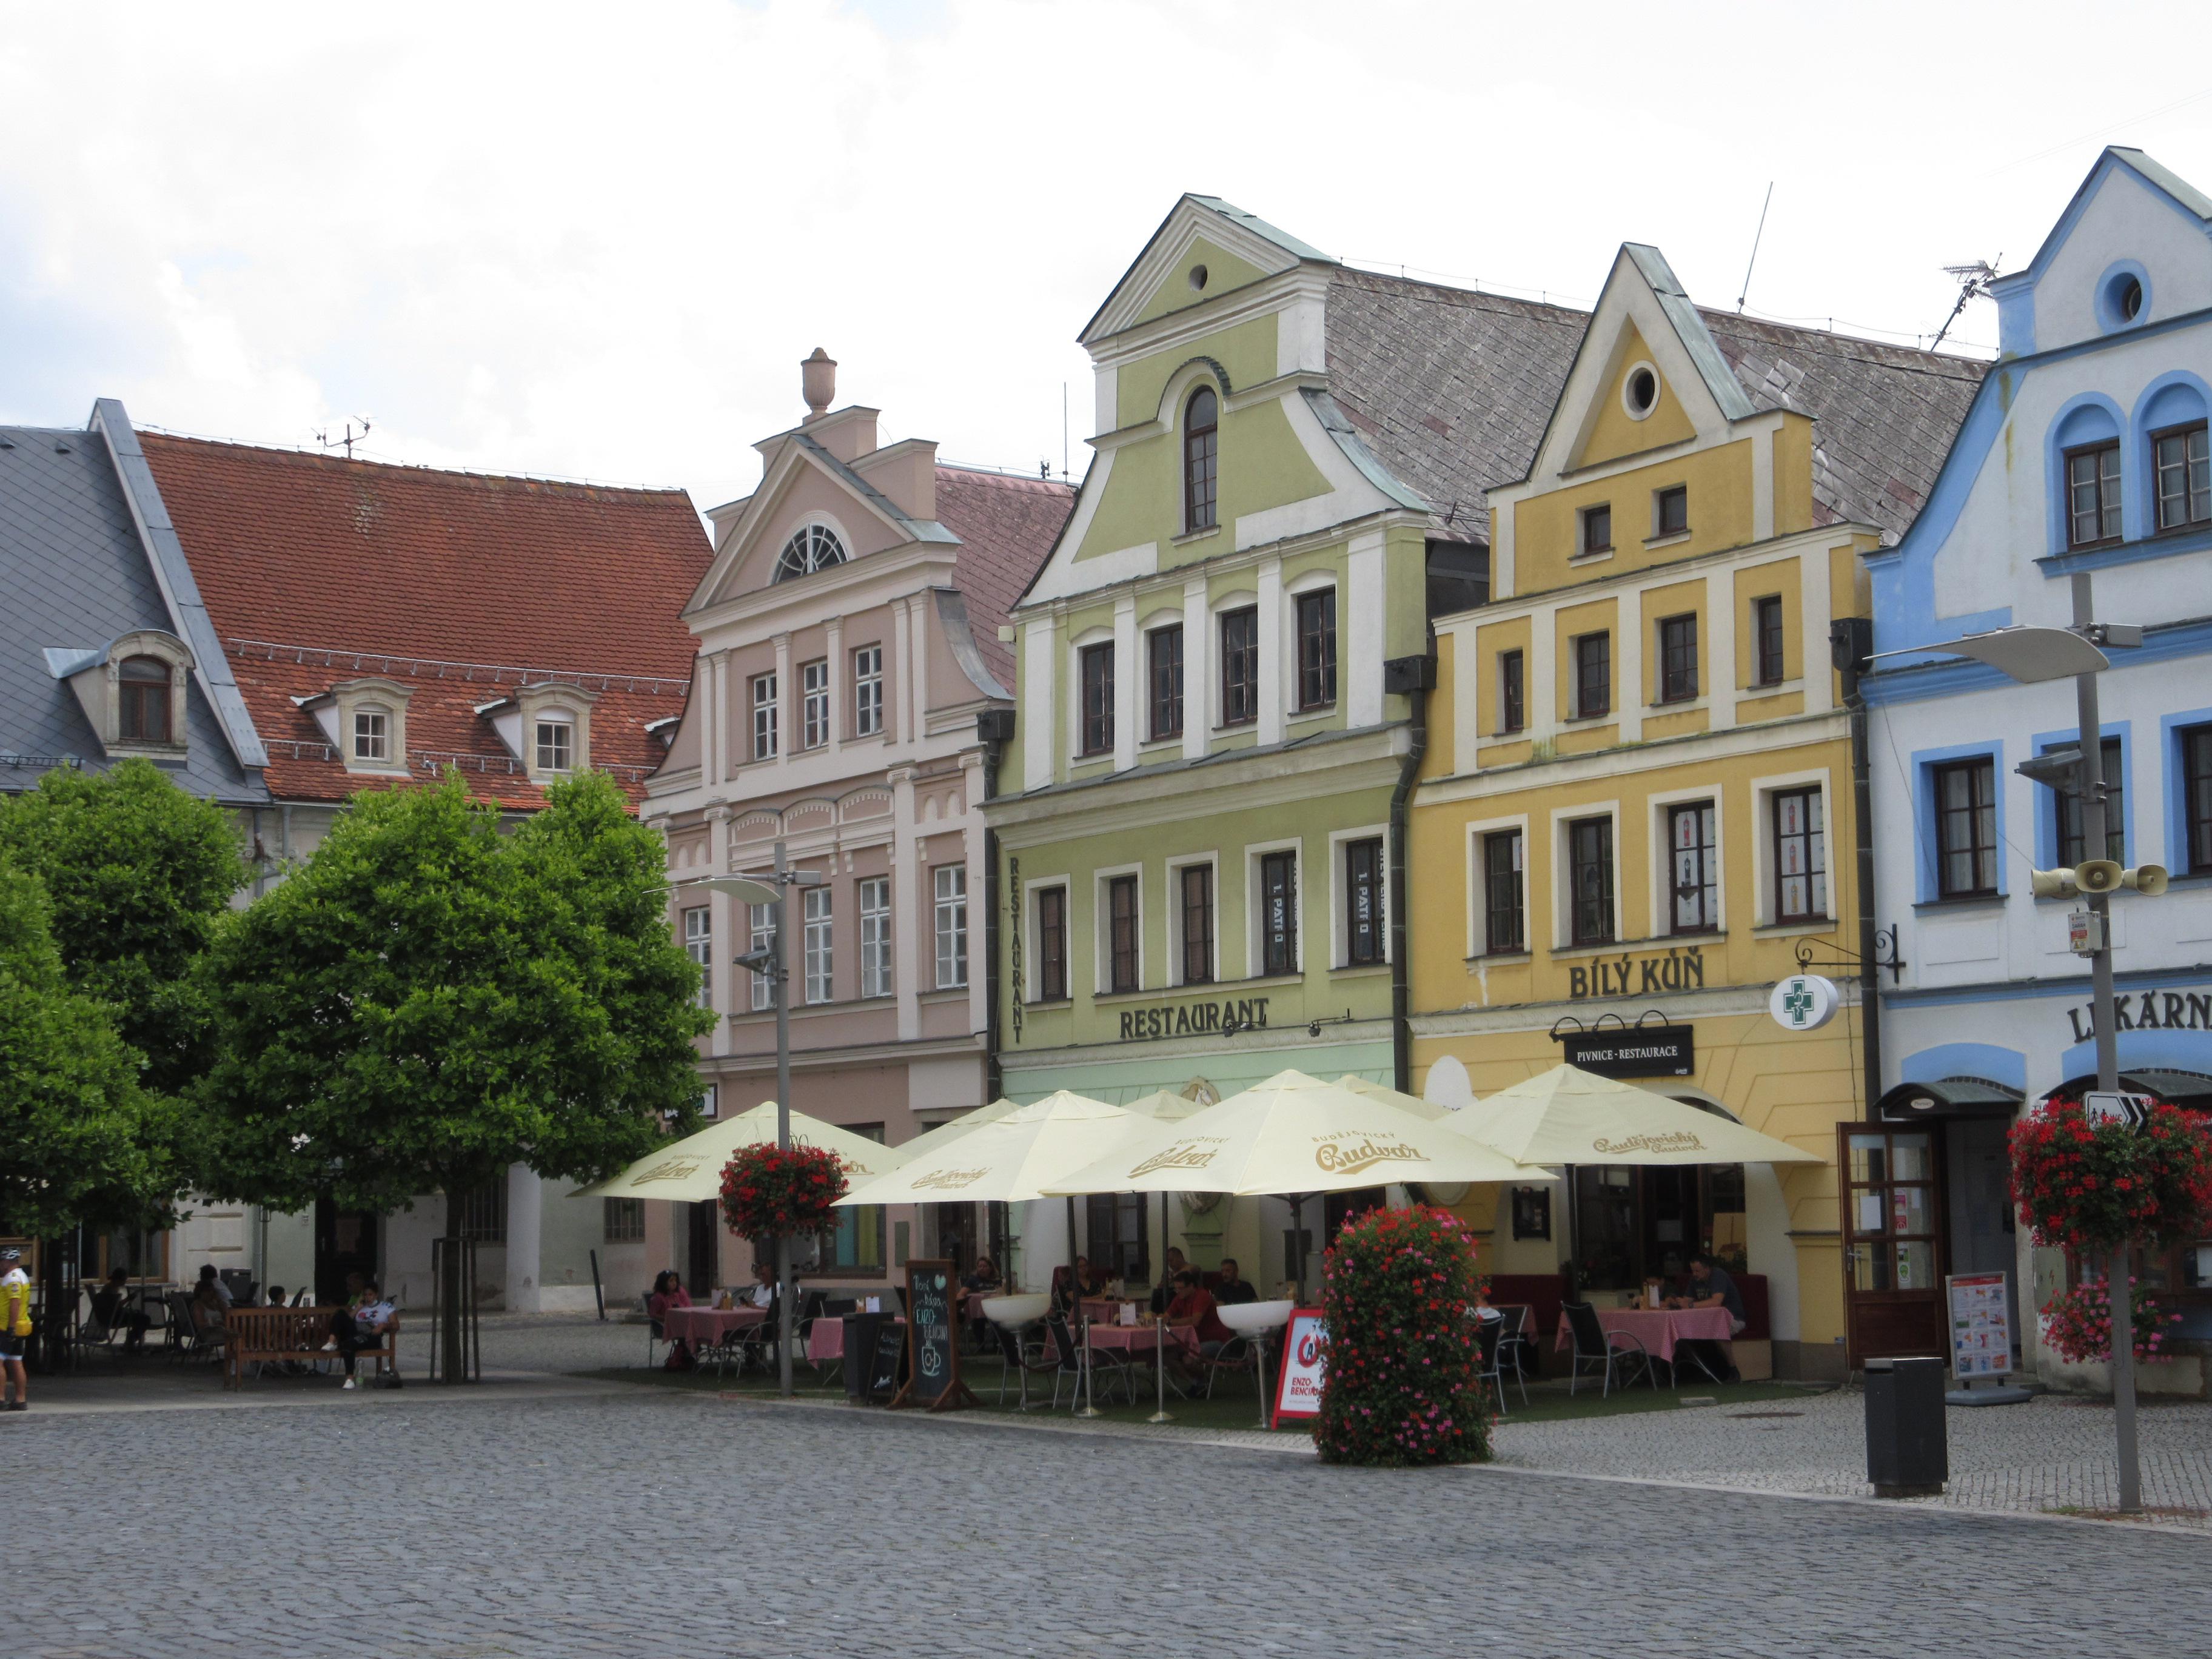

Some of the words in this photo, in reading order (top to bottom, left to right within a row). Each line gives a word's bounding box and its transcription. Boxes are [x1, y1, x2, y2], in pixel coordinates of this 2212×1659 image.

[1010, 857, 1022, 1044] RESTAURANT
[1569, 952, 1632, 998] BÍLÝ
[1640, 946, 1703, 993] KŮŇ
[1119, 997, 1269, 1039] RESTAURANT
[2067, 990, 2212, 1044] LKÁRN
[1577, 1050, 1614, 1062] PIVNICE
[1619, 1046, 1678, 1059] RESTAURACE
[1311, 1130, 1396, 1142] BUDĚJOVICKÝ
[1315, 1139, 1431, 1174] Budvar
